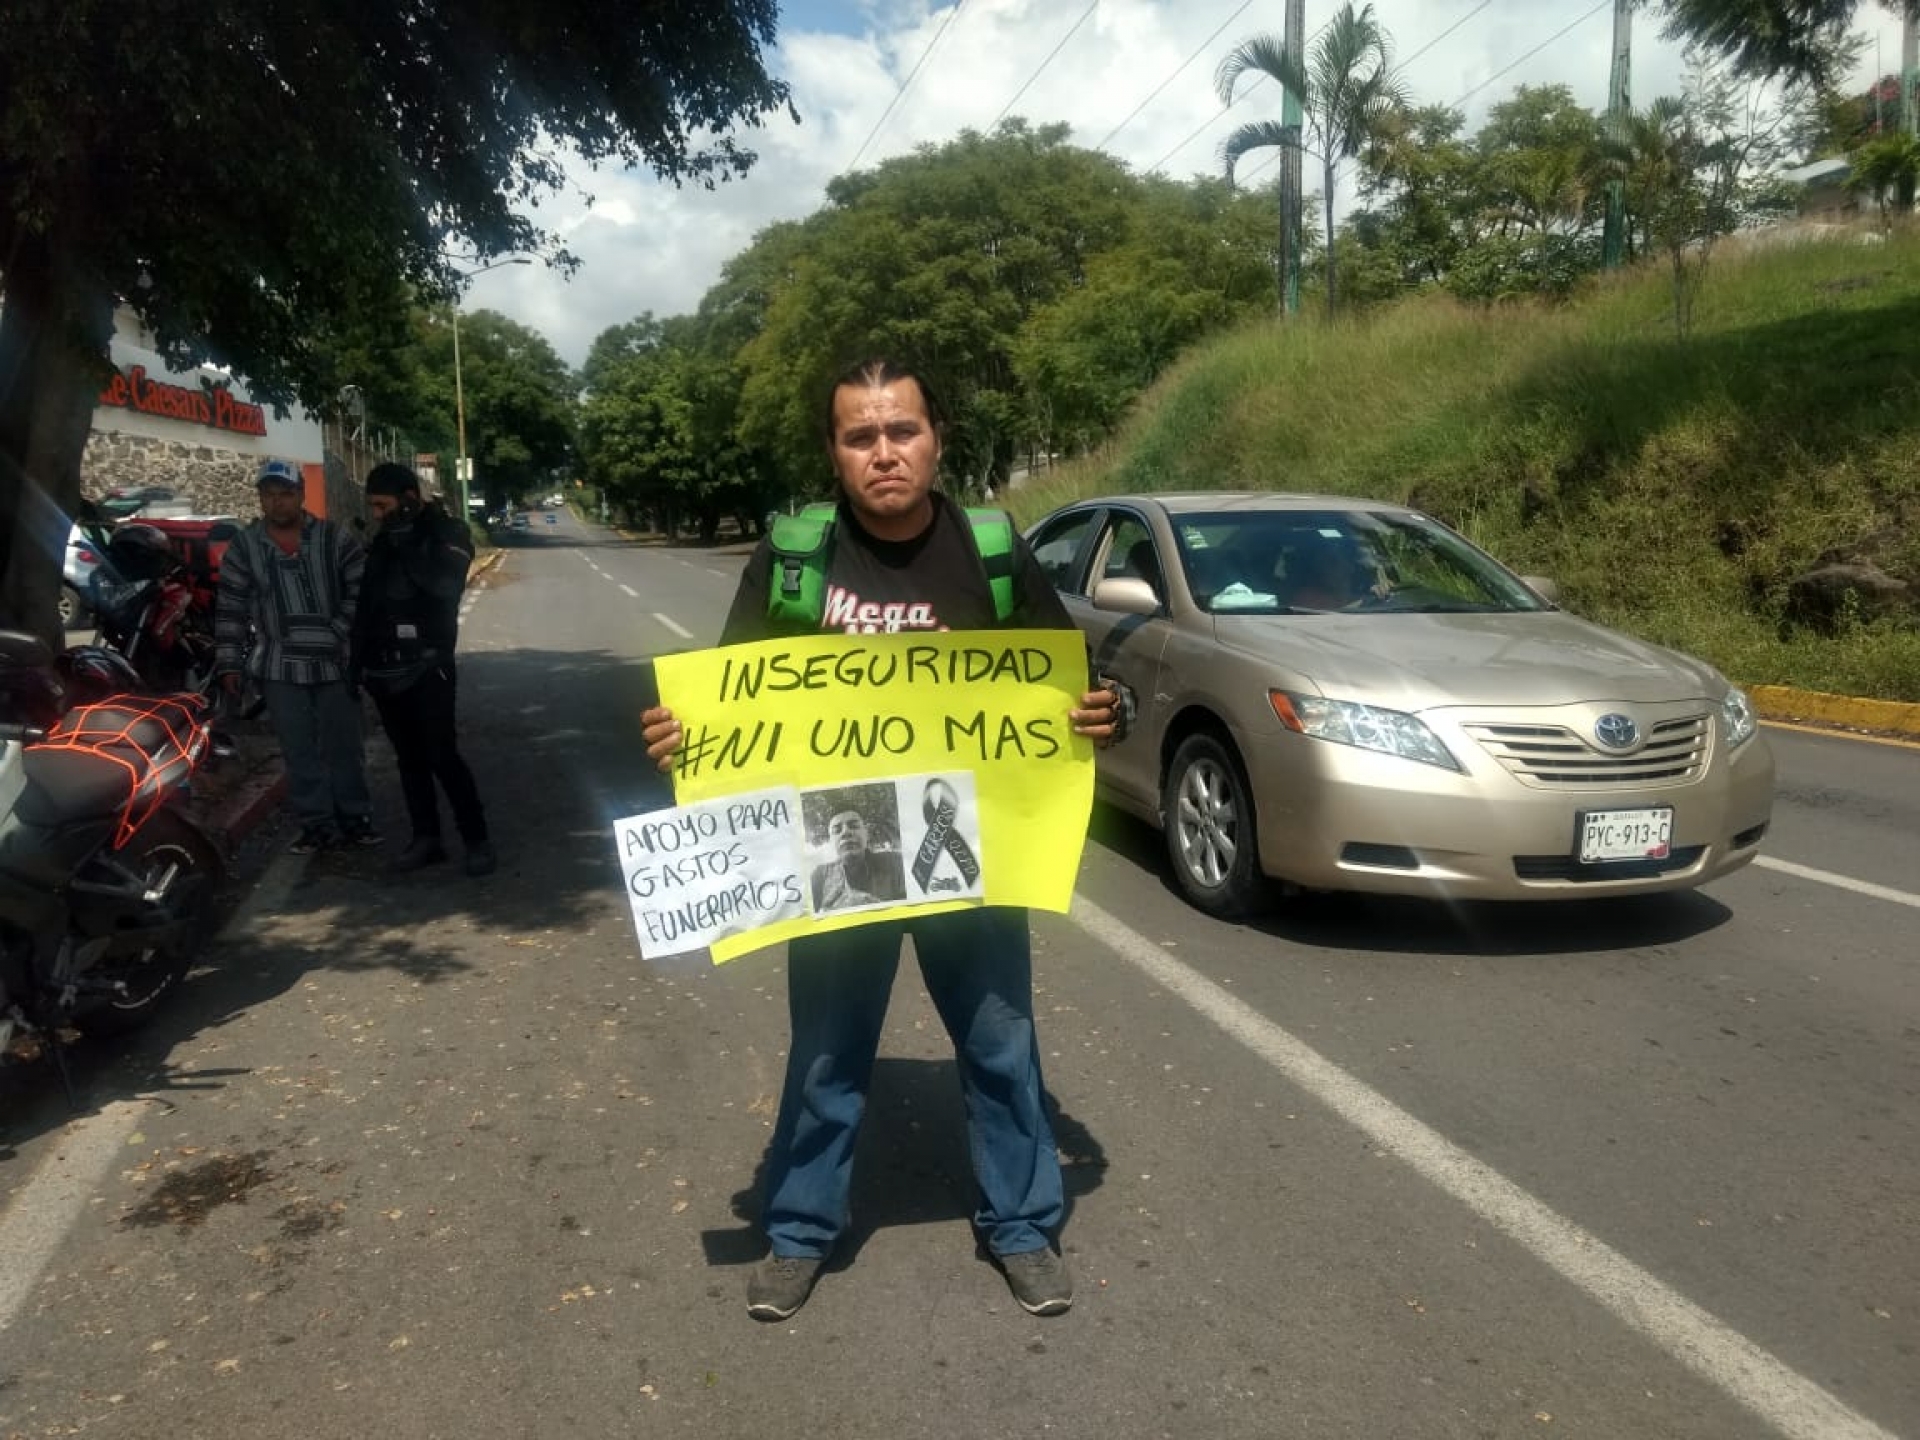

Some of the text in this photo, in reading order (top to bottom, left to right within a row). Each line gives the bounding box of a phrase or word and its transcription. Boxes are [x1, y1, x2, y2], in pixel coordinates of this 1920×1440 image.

[213, 387, 267, 436] Pizza
[822, 584, 937, 634] Mega
[719, 646, 1053, 702] INSEGURIDAD
[676, 710, 1060, 780] #NI UNO MAS
[626, 799, 790, 857] APOYO PARA
[1586, 822, 1668, 848] PYC-913-C
[630, 842, 749, 898] GASTOS
[643, 874, 802, 943] FUNERARIOS
